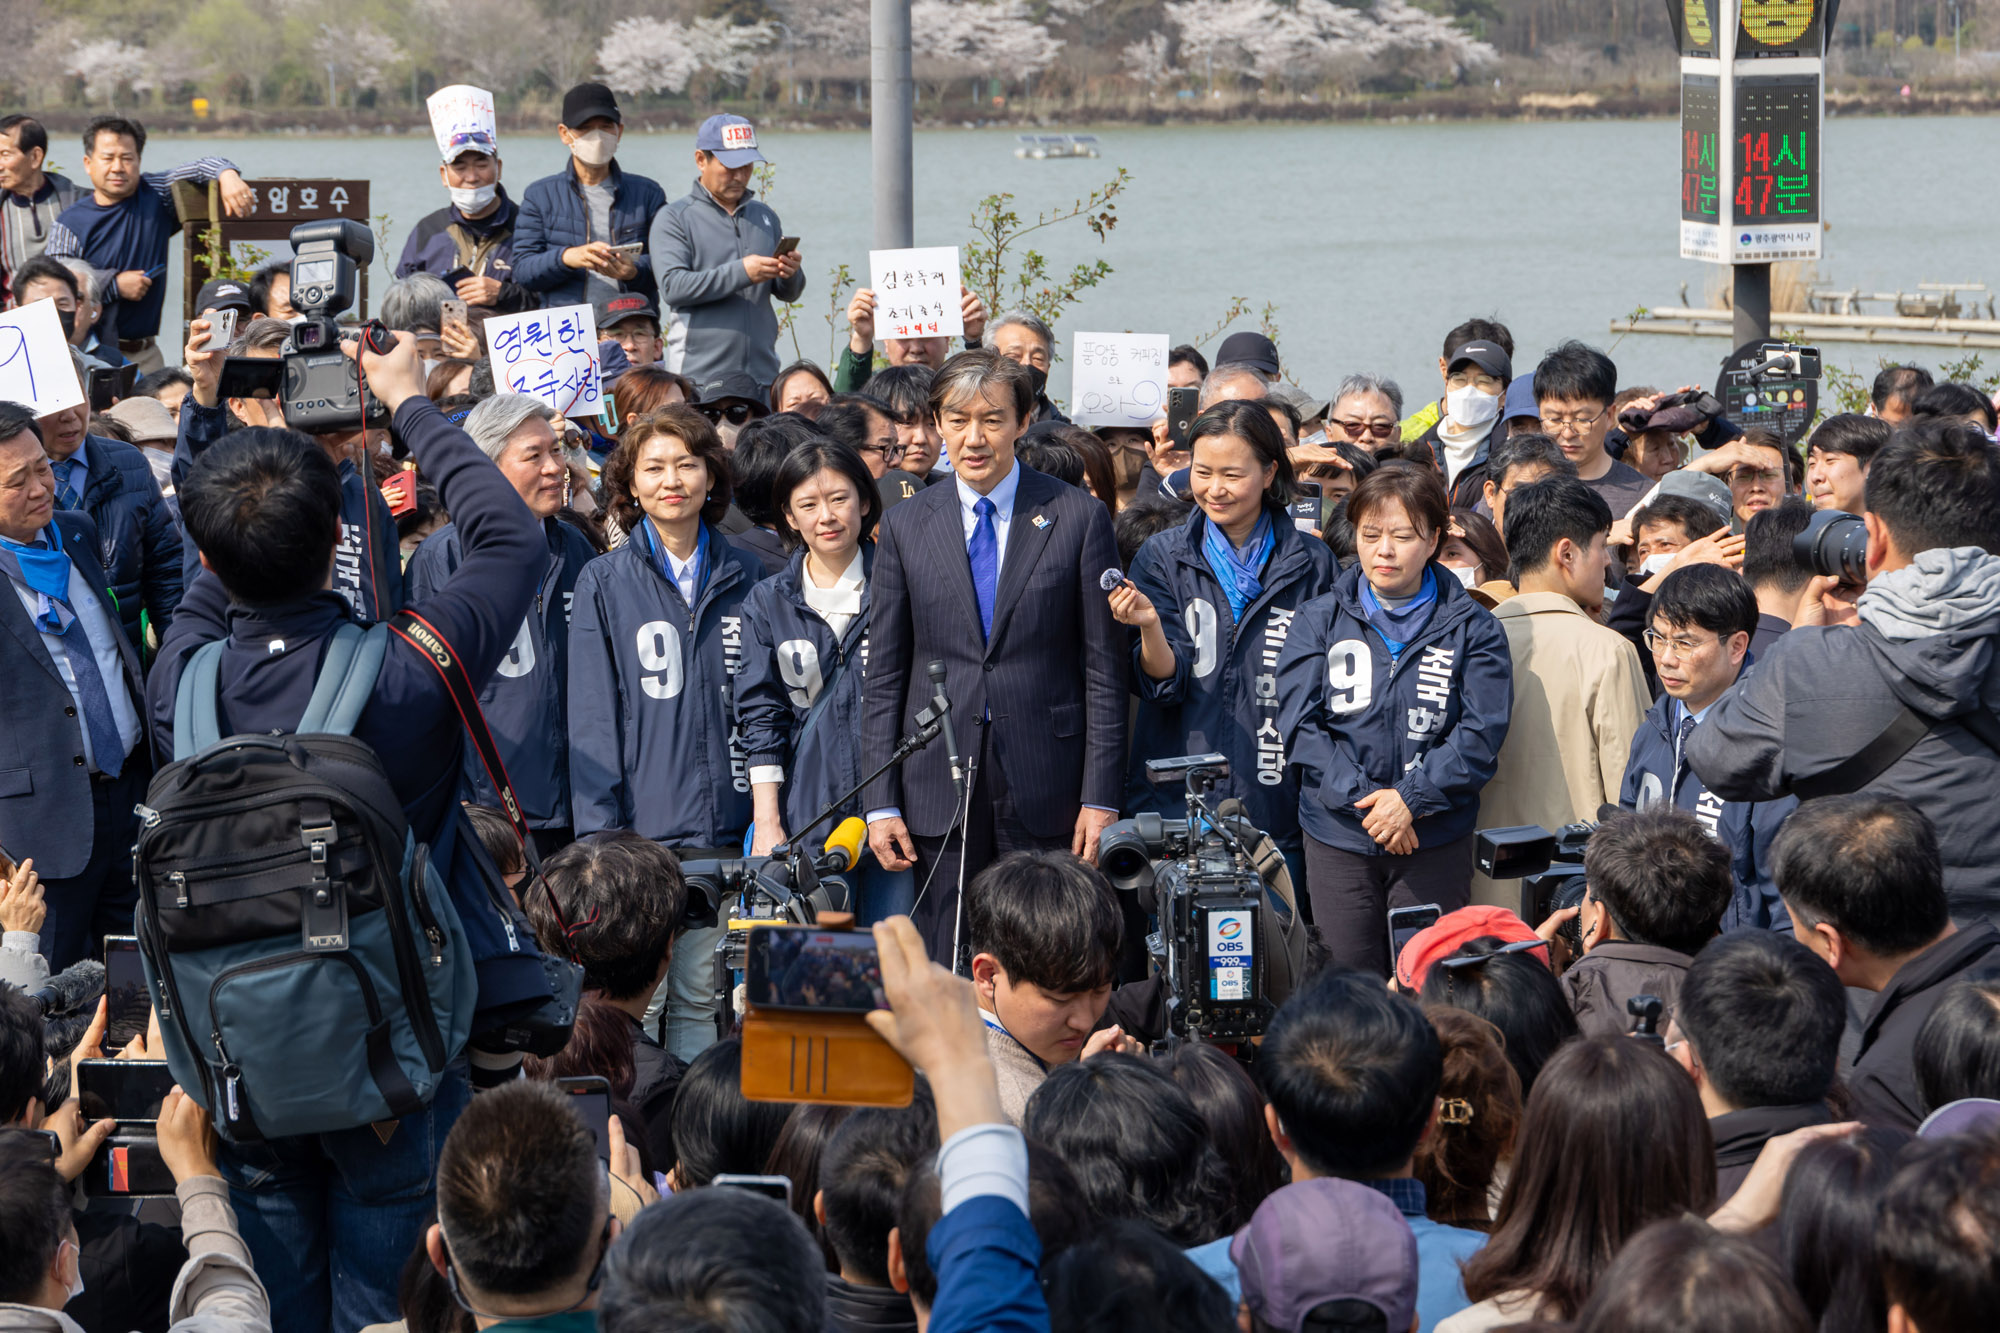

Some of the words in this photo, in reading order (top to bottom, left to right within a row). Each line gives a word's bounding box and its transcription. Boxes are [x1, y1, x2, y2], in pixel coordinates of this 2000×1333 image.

[1684, 130, 1715, 172] 14시
[1738, 131, 1806, 172] 14시
[1682, 173, 1717, 215] 47분
[1735, 174, 1810, 215] 47분
[1755, 232, 1794, 244] 광주광역시
[1796, 231, 1811, 242] 서구
[882, 270, 945, 290] 검찰독재
[494, 312, 585, 364] 영원한
[1130, 347, 1162, 367] 커피집
[1108, 376, 1123, 385] 으로
[407, 622, 452, 668] Canon
[1185, 598, 1217, 678] 9
[636, 620, 684, 700] 9
[777, 639, 824, 708] 9
[1328, 639, 1372, 716] 9
[502, 786, 521, 823] EOS
[309, 934, 343, 947] TUMI
[1216, 942, 1244, 952] OBS
